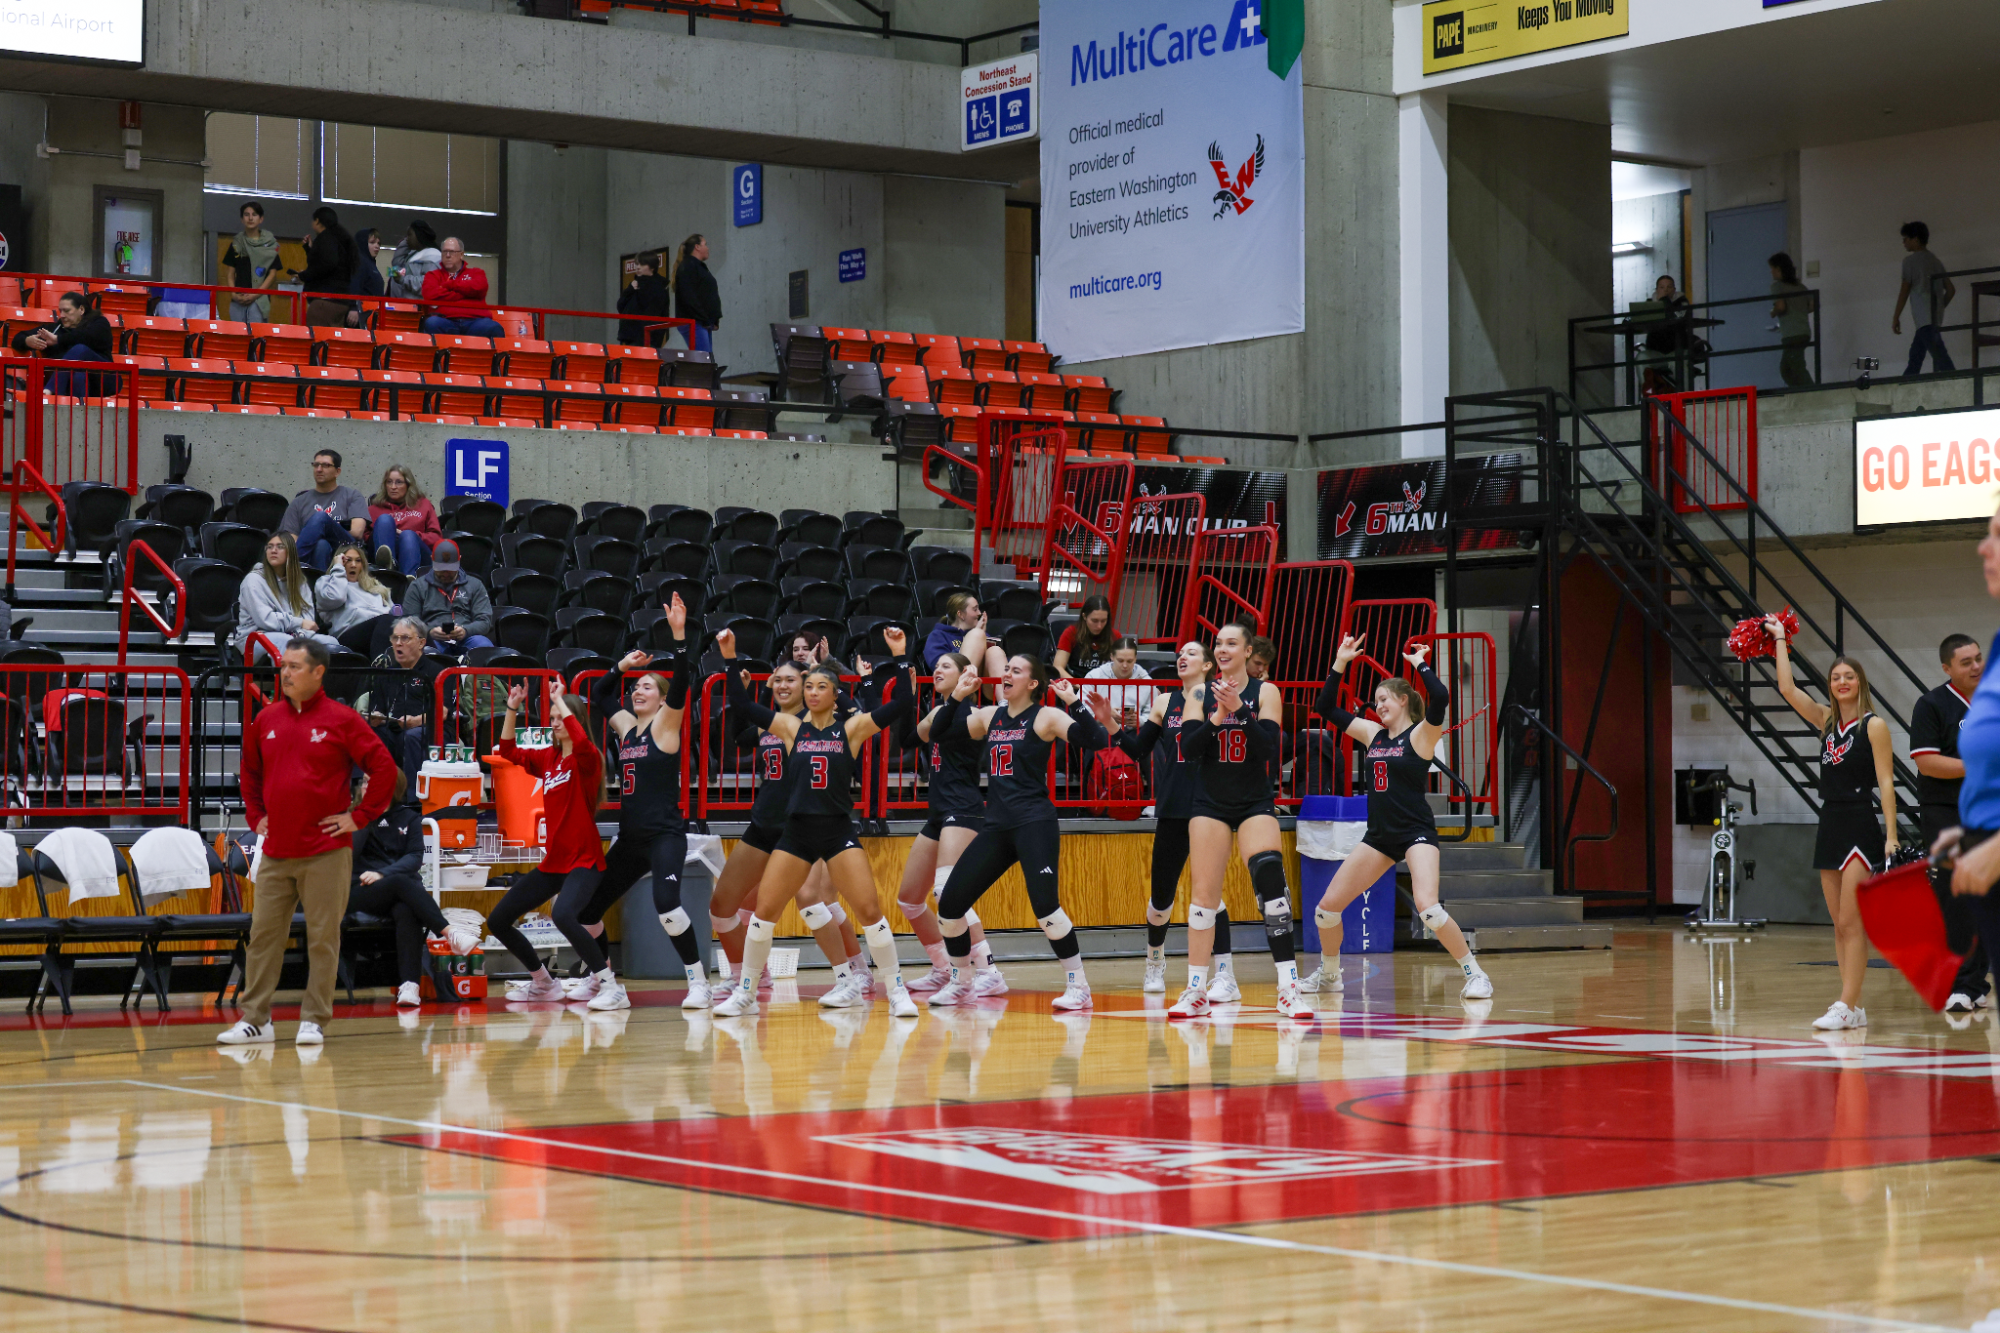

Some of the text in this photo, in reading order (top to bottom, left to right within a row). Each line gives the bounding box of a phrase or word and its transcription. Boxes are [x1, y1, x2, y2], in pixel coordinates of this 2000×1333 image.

[51, 13, 114, 34] Airport
[1468, 21, 1498, 35] MACHINERY
[1518, 0, 1614, 30] Keeps You Moving
[1071, 23, 1217, 87] MultiCare
[965, 72, 1032, 98] Concession Stand
[979, 64, 1017, 81] Northeast
[974, 130, 990, 140] MENS
[1005, 122, 1025, 133] PHONE
[1069, 108, 1164, 144] Official medical
[1069, 146, 1136, 181] provider of
[740, 170, 754, 198] G
[1070, 171, 1197, 207] Eastern Washington
[1070, 205, 1189, 239] University Athletics
[1070, 271, 1162, 299] multicare.org
[455, 449, 501, 488] LF
[1863, 444, 1910, 493] GO
[1386, 511, 1437, 533] MAN
[990, 743, 1013, 777] 12
[1217, 728, 1247, 763] 18
[622, 762, 636, 796] 5
[762, 747, 783, 780] 13
[810, 755, 829, 790] 3
[1373, 760, 1389, 793] 8
[458, 980, 471, 995] G
